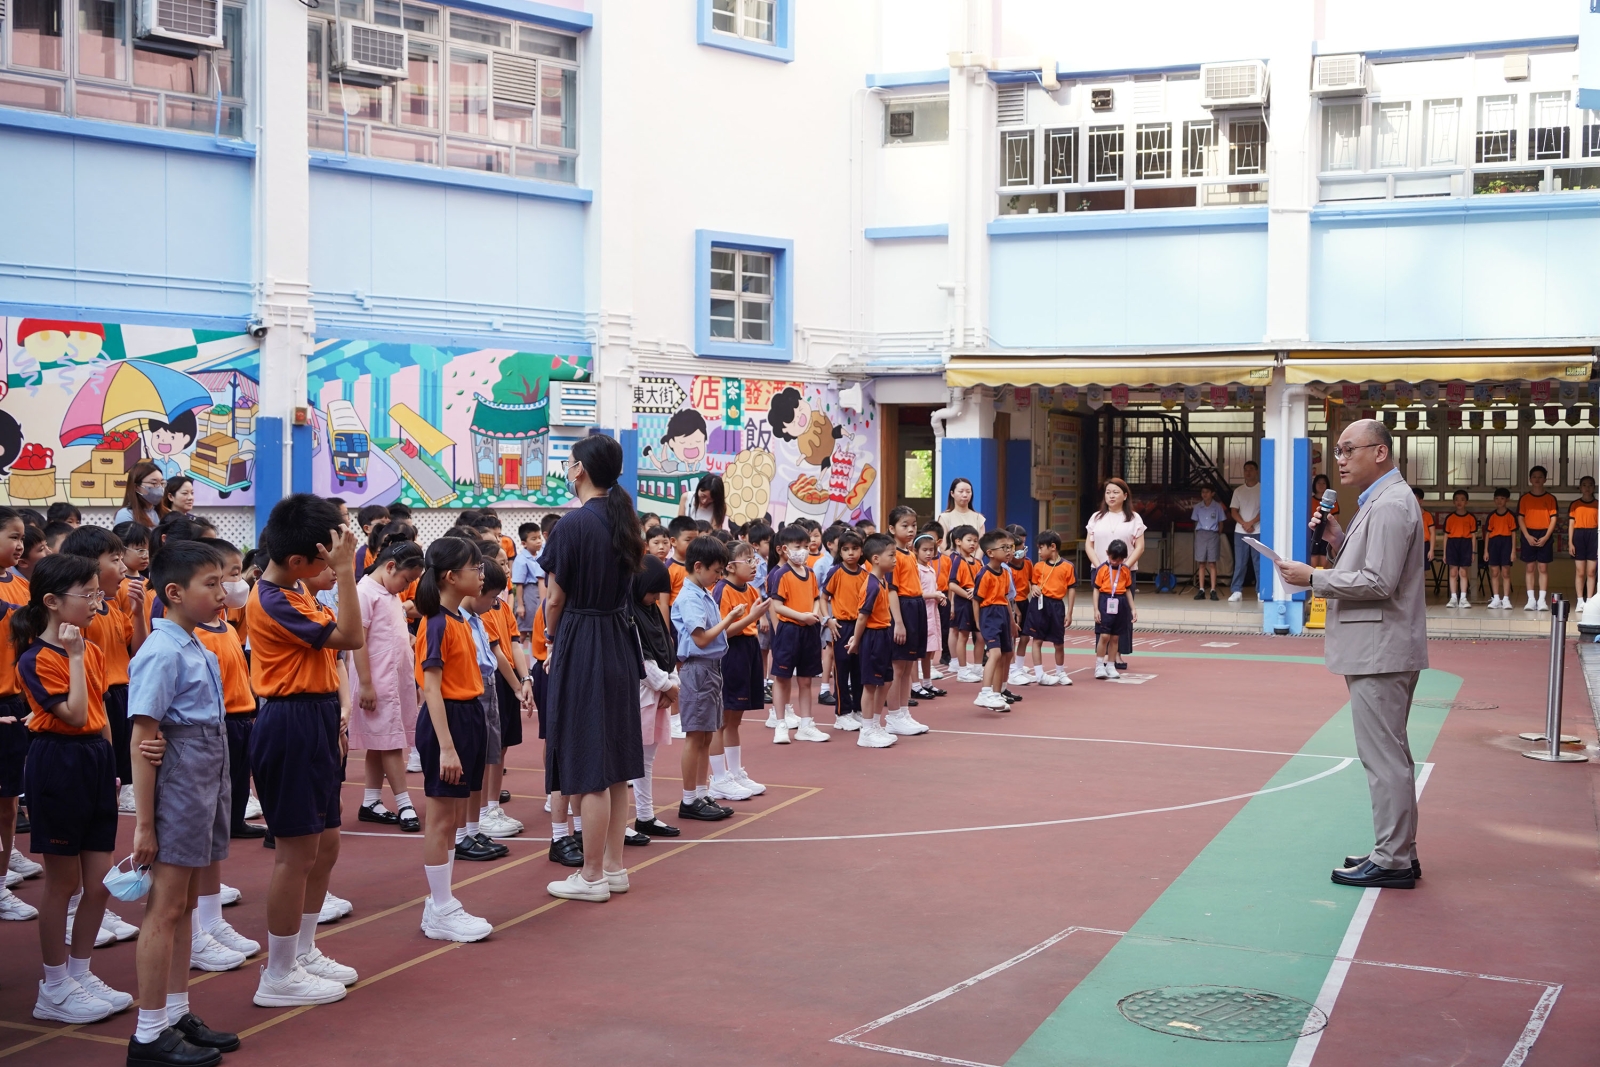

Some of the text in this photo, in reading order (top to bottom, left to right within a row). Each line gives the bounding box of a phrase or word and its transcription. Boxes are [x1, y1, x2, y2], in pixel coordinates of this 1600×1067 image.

[633, 386, 674, 405] 東大街
[697, 376, 721, 411] 店
[744, 417, 772, 453] 飯
